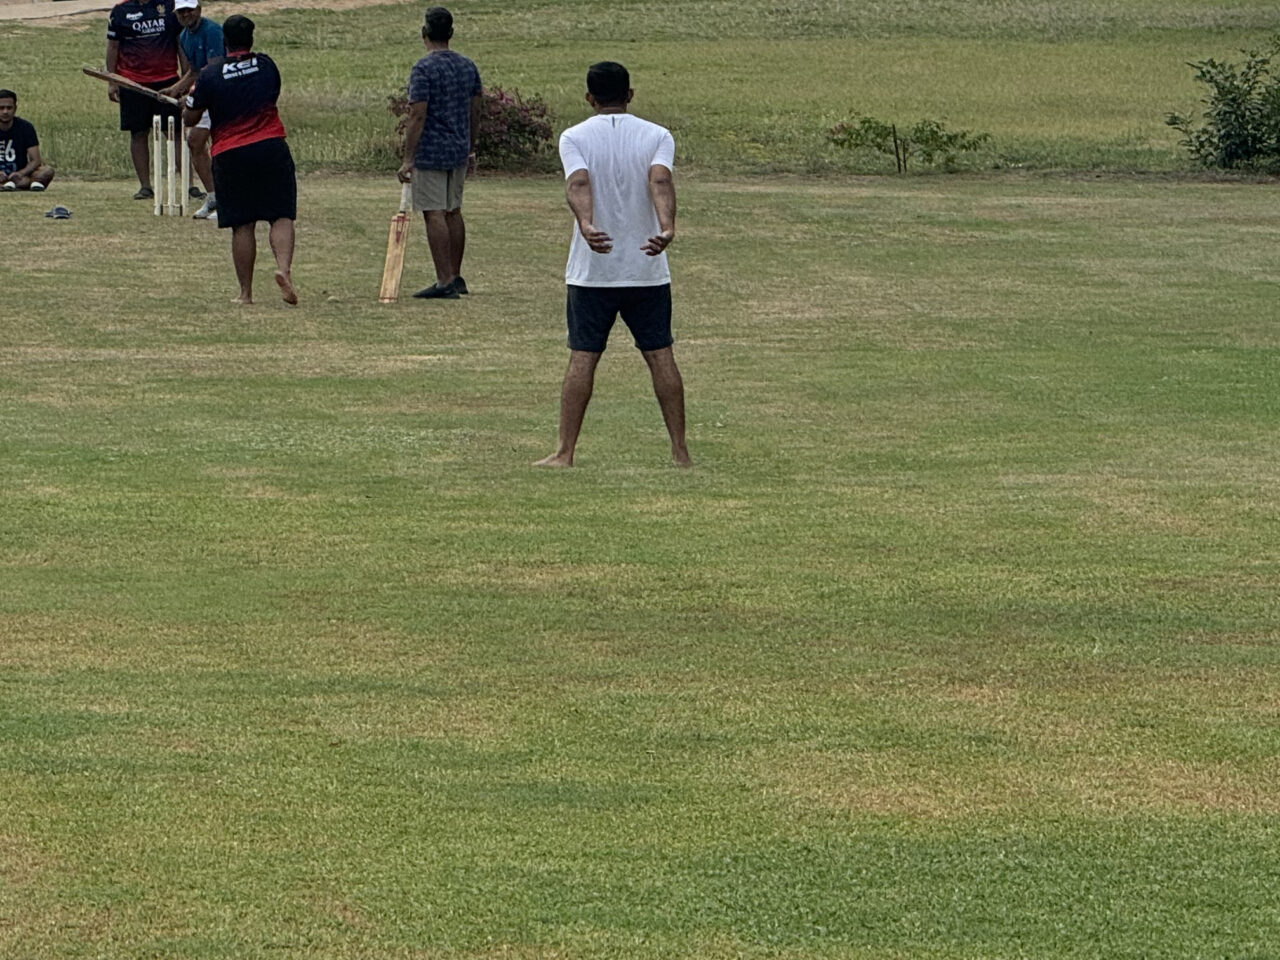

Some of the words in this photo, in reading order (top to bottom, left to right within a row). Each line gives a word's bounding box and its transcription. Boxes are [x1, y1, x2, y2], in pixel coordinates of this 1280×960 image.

[132, 18, 166, 32] QATAR
[222, 57, 258, 74] KEI
[5, 139, 16, 162] 6
